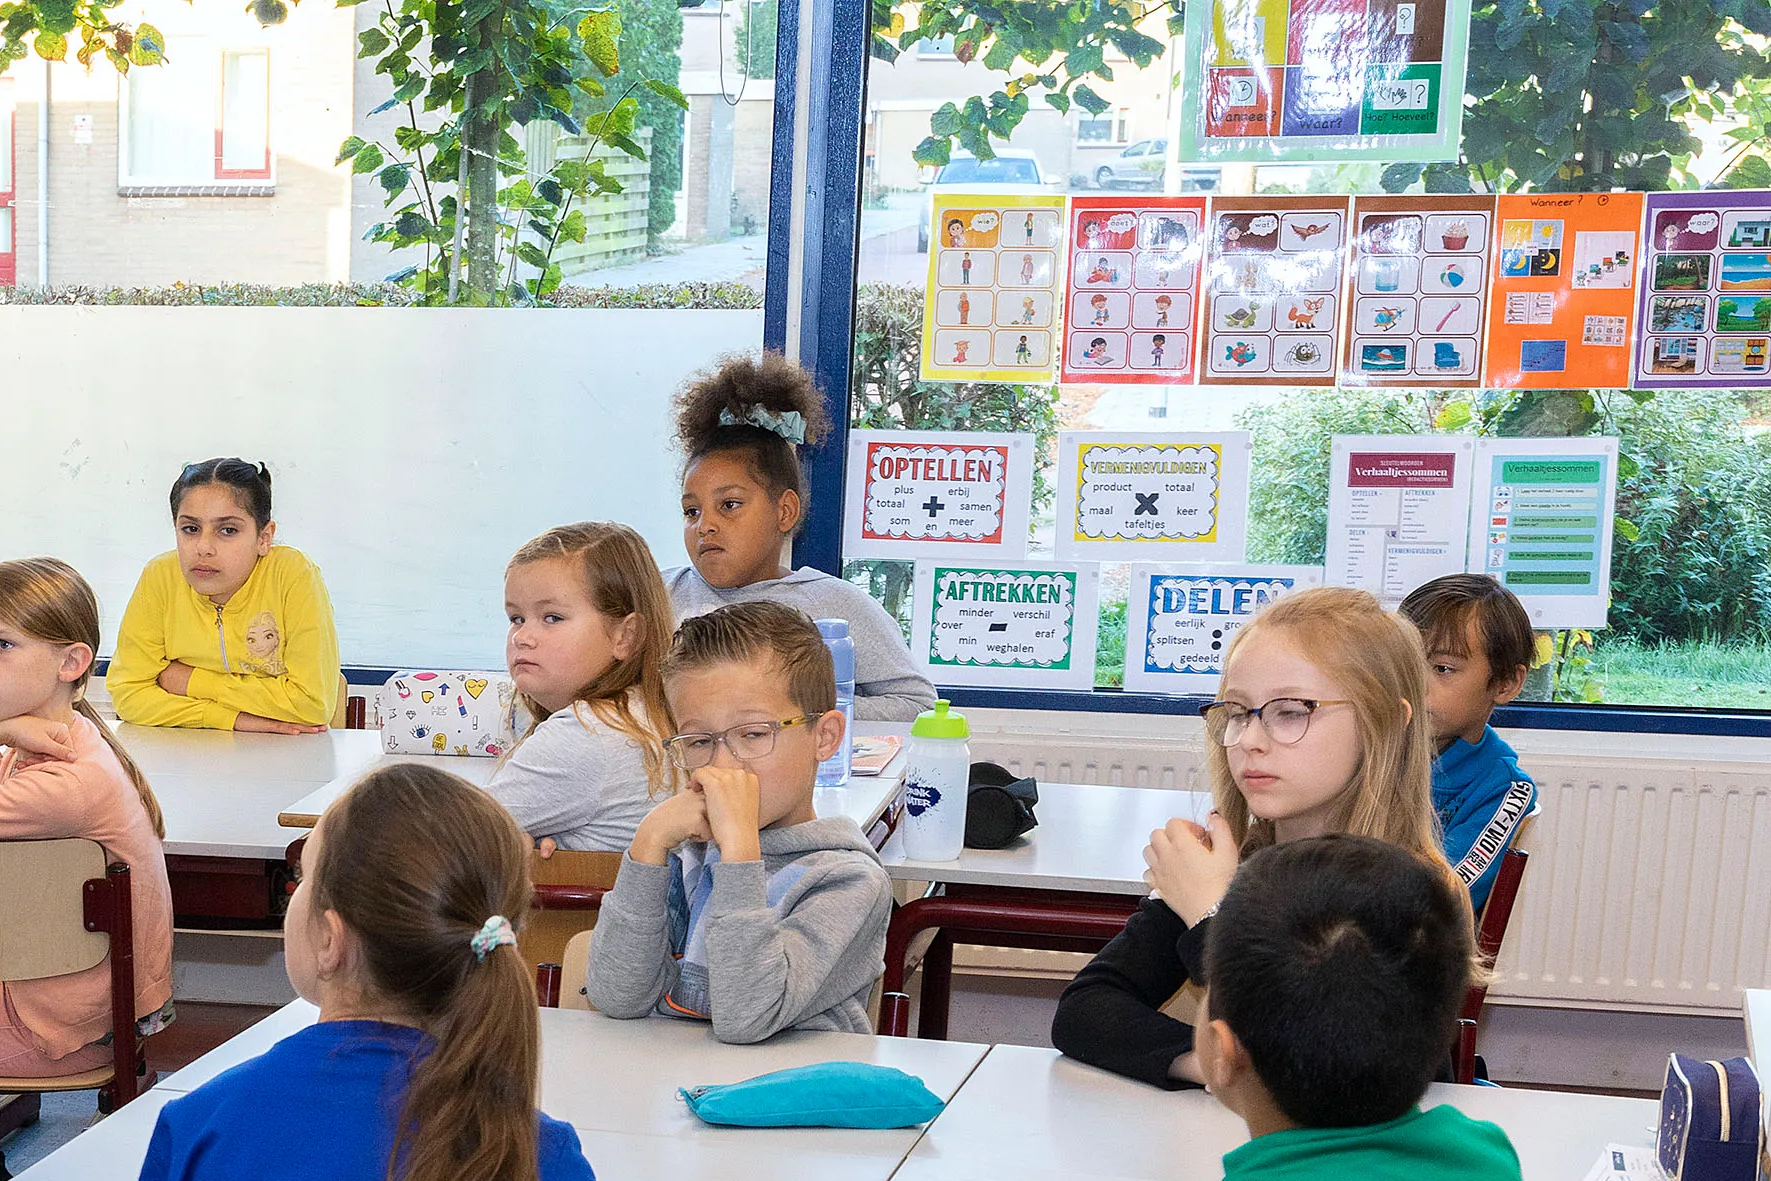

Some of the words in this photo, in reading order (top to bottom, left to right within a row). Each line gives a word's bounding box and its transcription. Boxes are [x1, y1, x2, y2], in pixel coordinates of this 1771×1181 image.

[1299, 118, 1342, 130] Waar?
[1530, 197, 1574, 207] Wanneer
[1255, 220, 1276, 229] wat?
[1688, 219, 1716, 228] waar?
[879, 456, 992, 483] OPTELLEN
[1090, 461, 1207, 475] VERMENIGVULDIGEN
[1355, 467, 1448, 478] Verhaaltjessommen
[1508, 464, 1595, 474] Verhaaltjessommen
[894, 485, 915, 496] plus
[948, 486, 970, 498] erbij
[1092, 482, 1132, 493] product
[1165, 483, 1195, 492] totaal
[876, 499, 905, 509] totaal
[960, 503, 992, 512] samen
[1089, 506, 1114, 515] maal
[1176, 507, 1199, 516] keer
[890, 517, 911, 525] som
[949, 517, 975, 526] meer
[1124, 520, 1166, 530] tafeltjes
[925, 523, 938, 531] en
[945, 580, 1062, 604] AFTREKKEN
[1162, 587, 1278, 615] DELEN
[959, 608, 995, 618] minder
[1012, 610, 1051, 620] verschil
[941, 622, 964, 630] over
[1175, 619, 1206, 630] eerlijk
[1035, 629, 1056, 638] eraf
[958, 636, 977, 645] min
[1156, 635, 1194, 646] splitsen
[986, 642, 1034, 654] weghalen
[1180, 654, 1220, 665] gedeeld
[1479, 782, 1530, 855] SIXTY-TWO
